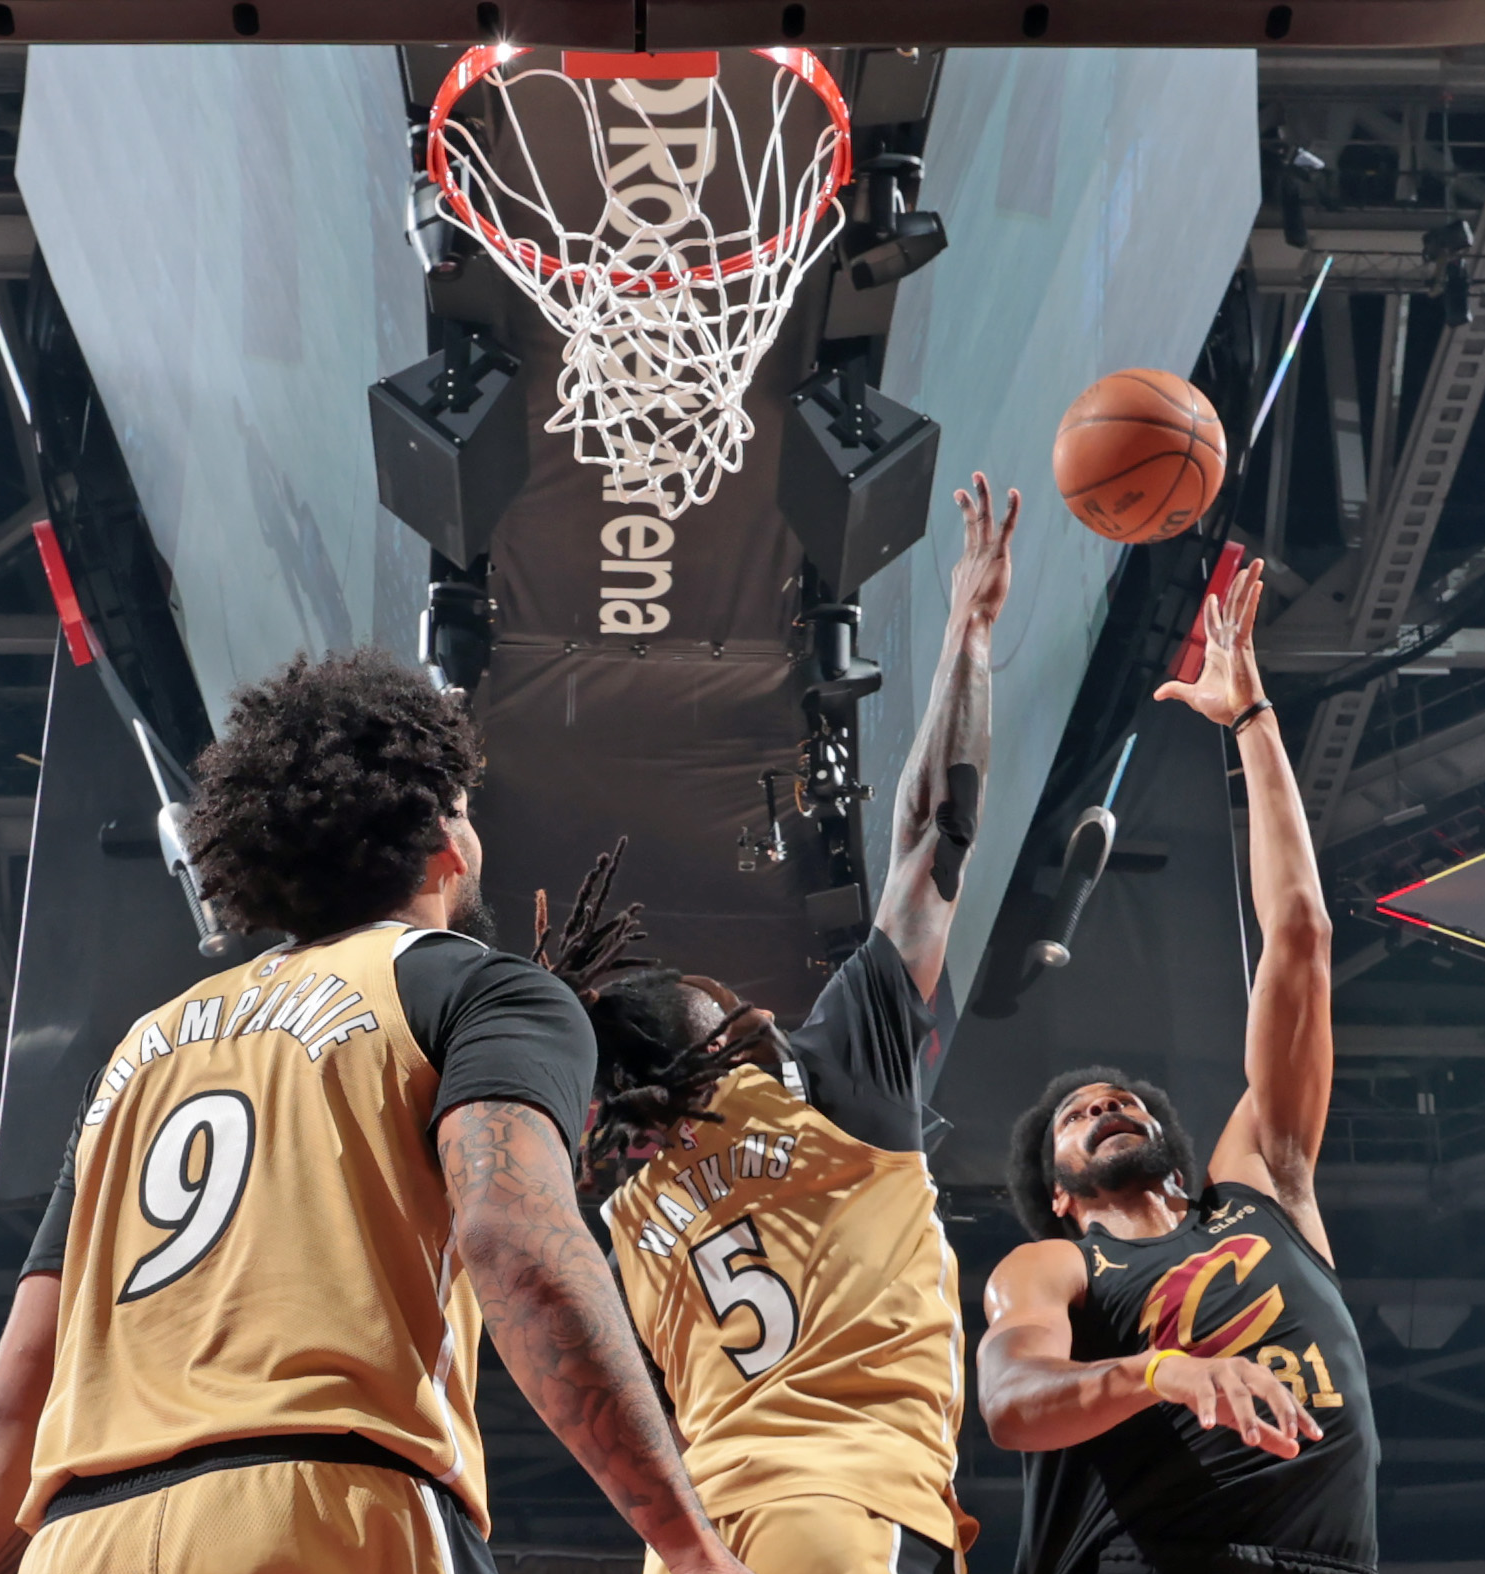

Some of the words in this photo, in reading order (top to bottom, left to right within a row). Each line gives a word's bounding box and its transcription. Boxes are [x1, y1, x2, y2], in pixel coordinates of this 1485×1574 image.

[600, 430, 700, 635] Arena
[83, 972, 380, 1126] CHAMPAGNIE
[115, 1089, 256, 1305] 9
[637, 1133, 796, 1258] WATKINS
[687, 1214, 800, 1382] 5
[1255, 1341, 1345, 1408] 31
